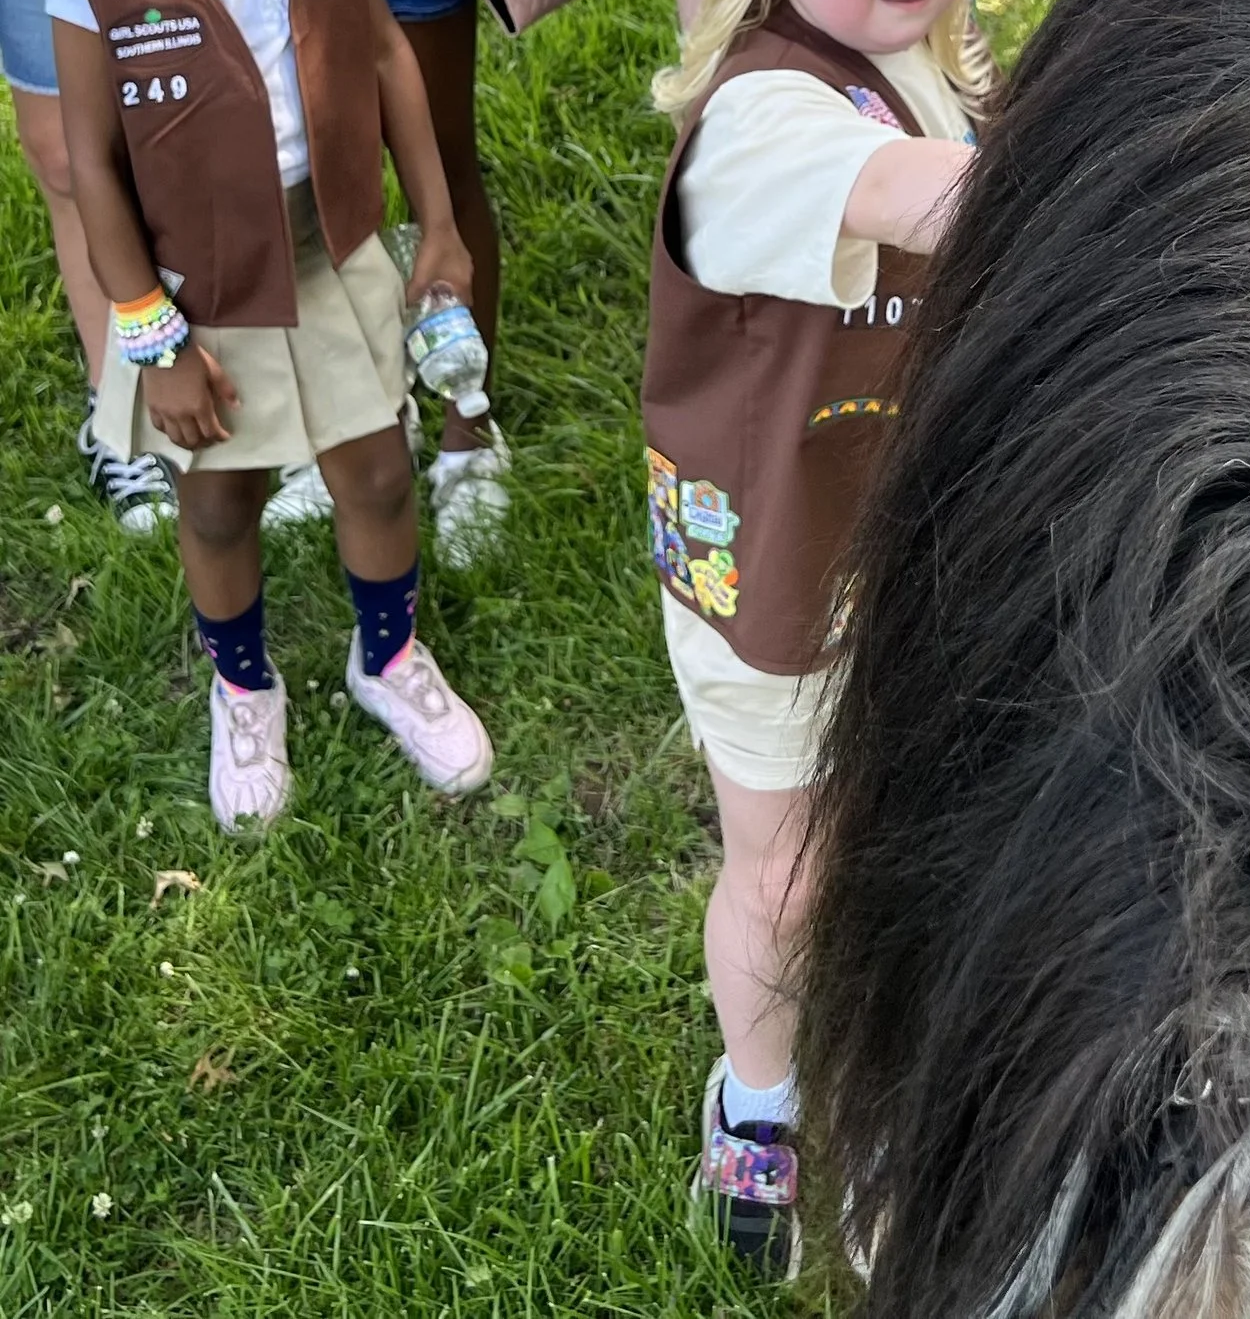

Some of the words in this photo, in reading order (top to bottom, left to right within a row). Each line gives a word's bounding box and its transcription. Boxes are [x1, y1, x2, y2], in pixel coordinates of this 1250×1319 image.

[133, 19, 178, 37] SCOUTS
[178, 16, 200, 31] USA
[116, 40, 164, 59] SOUTHERN
